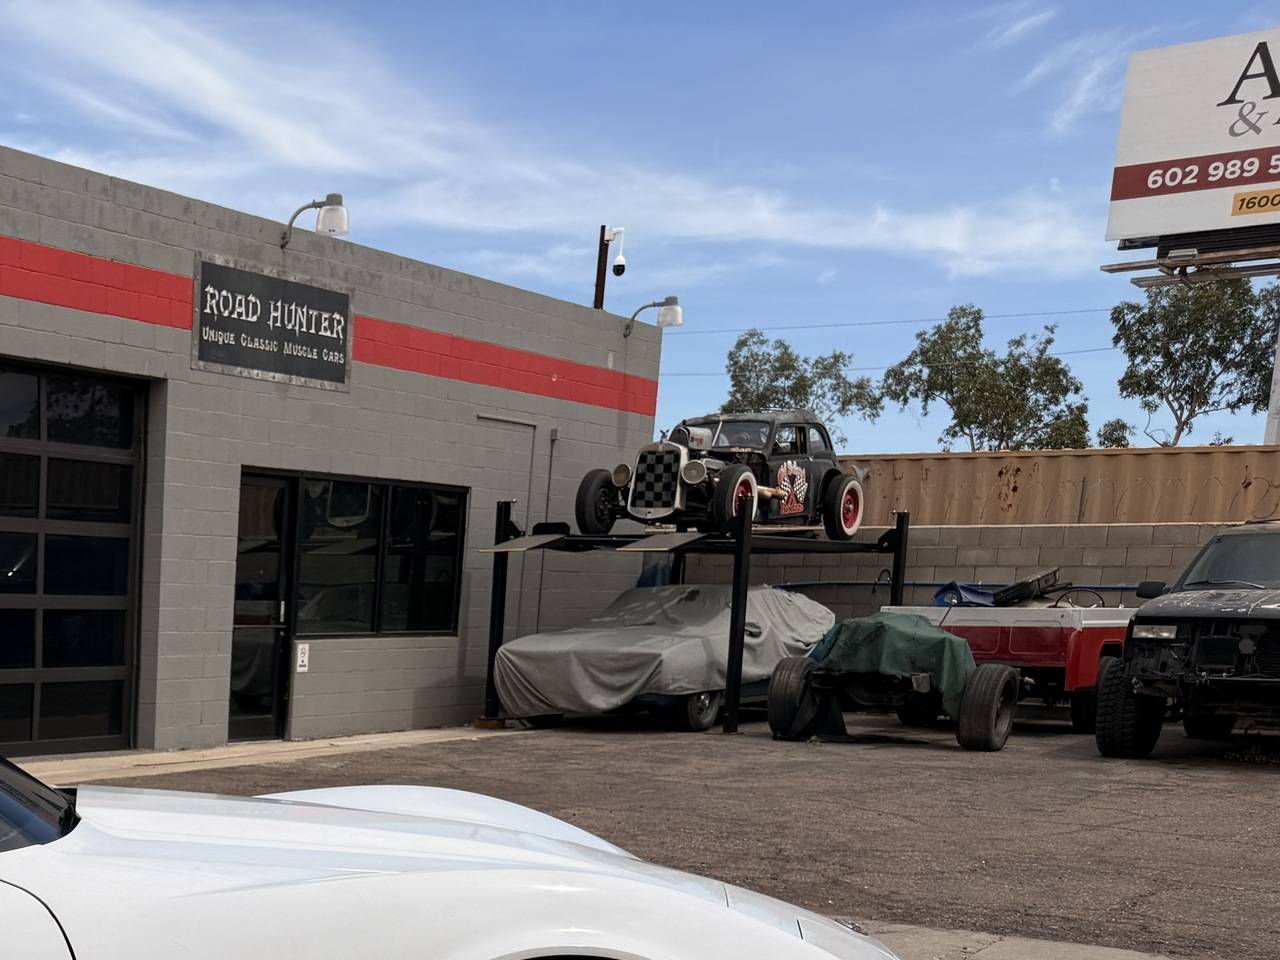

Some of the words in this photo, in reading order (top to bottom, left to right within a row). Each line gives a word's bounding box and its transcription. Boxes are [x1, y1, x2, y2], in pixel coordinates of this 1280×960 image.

[1229, 101, 1269, 137] &
[1147, 165, 1199, 189] 602
[1207, 157, 1260, 182] 989
[204, 284, 261, 322] ROAD
[267, 299, 345, 343] HUNTER
[202, 327, 235, 345] UNIQUE
[241, 333, 278, 352] CLASSIC
[283, 341, 318, 360] MUSCLE
[322, 348, 345, 364] CARS
